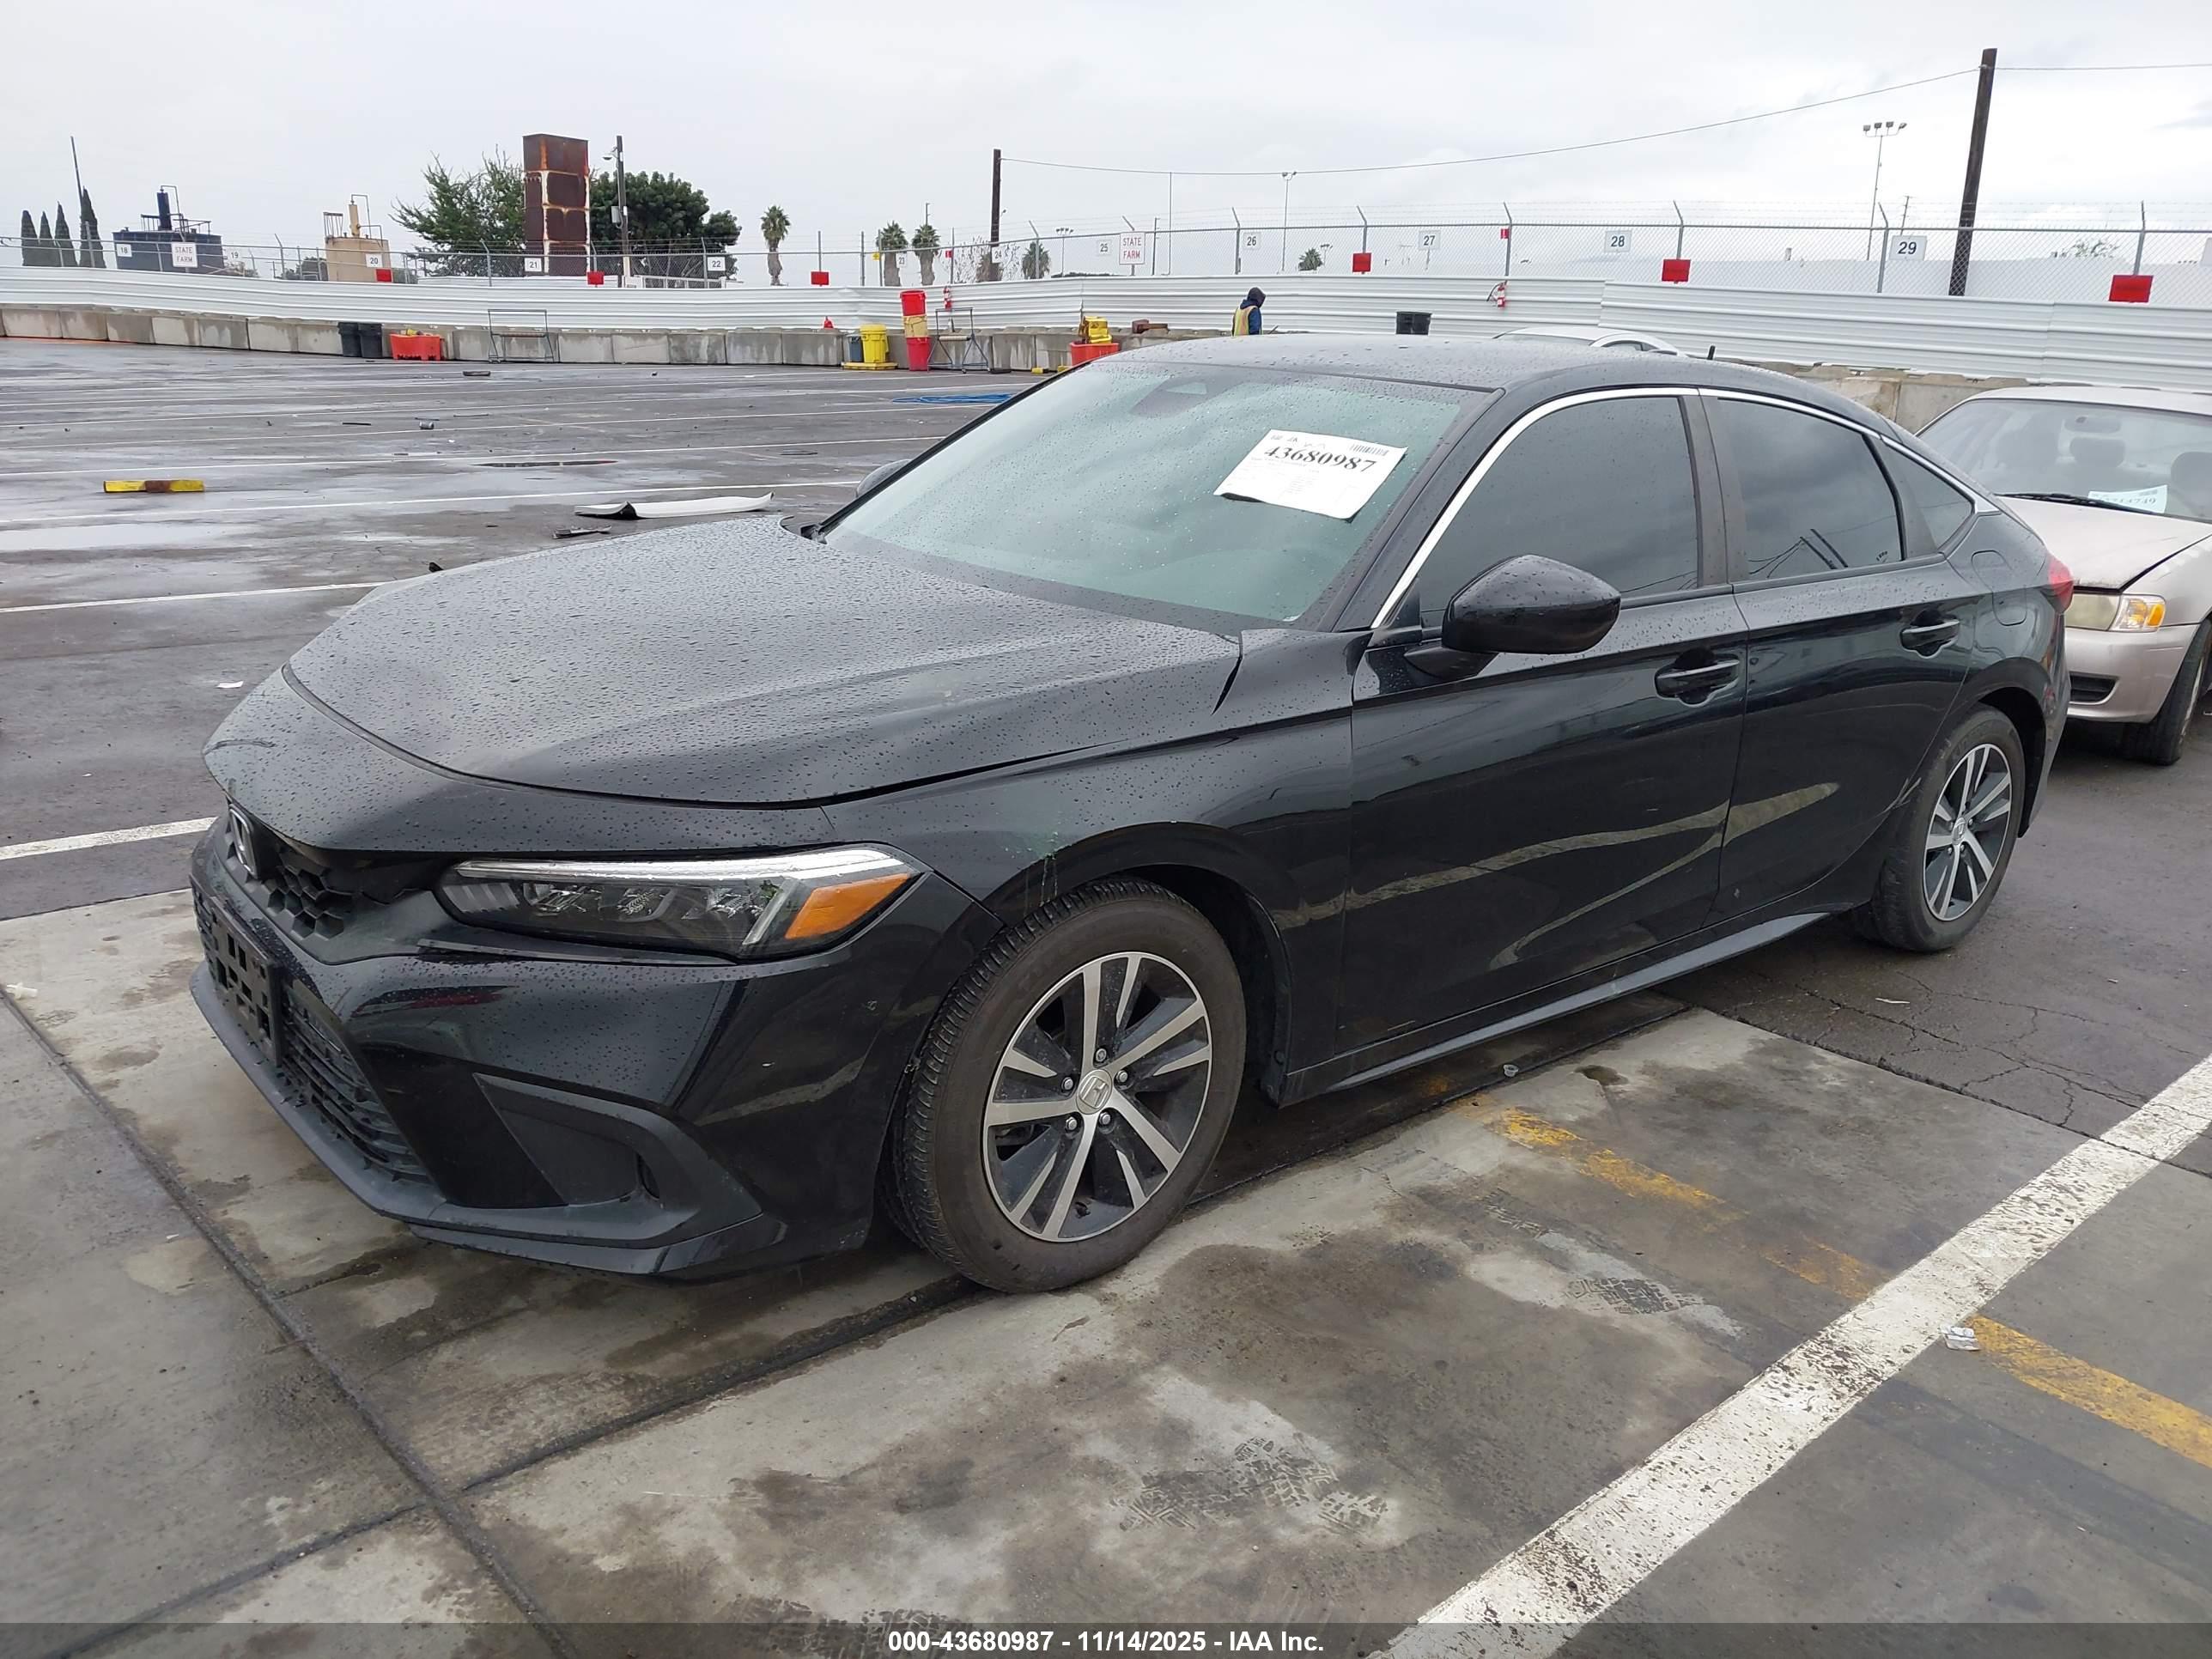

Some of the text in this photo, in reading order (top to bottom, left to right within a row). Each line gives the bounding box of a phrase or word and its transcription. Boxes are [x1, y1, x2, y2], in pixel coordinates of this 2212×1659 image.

[1122, 237, 1142, 246] STATE
[1247, 236, 1257, 246] 26
[1423, 235, 1436, 246] 27
[1611, 235, 1626, 247] 28
[1100, 243, 1109, 252] 25
[1898, 241, 1917, 255] 29
[1123, 250, 1141, 258] FARM
[898, 257, 905, 265] 23
[1264, 446, 1377, 472] 43680987
